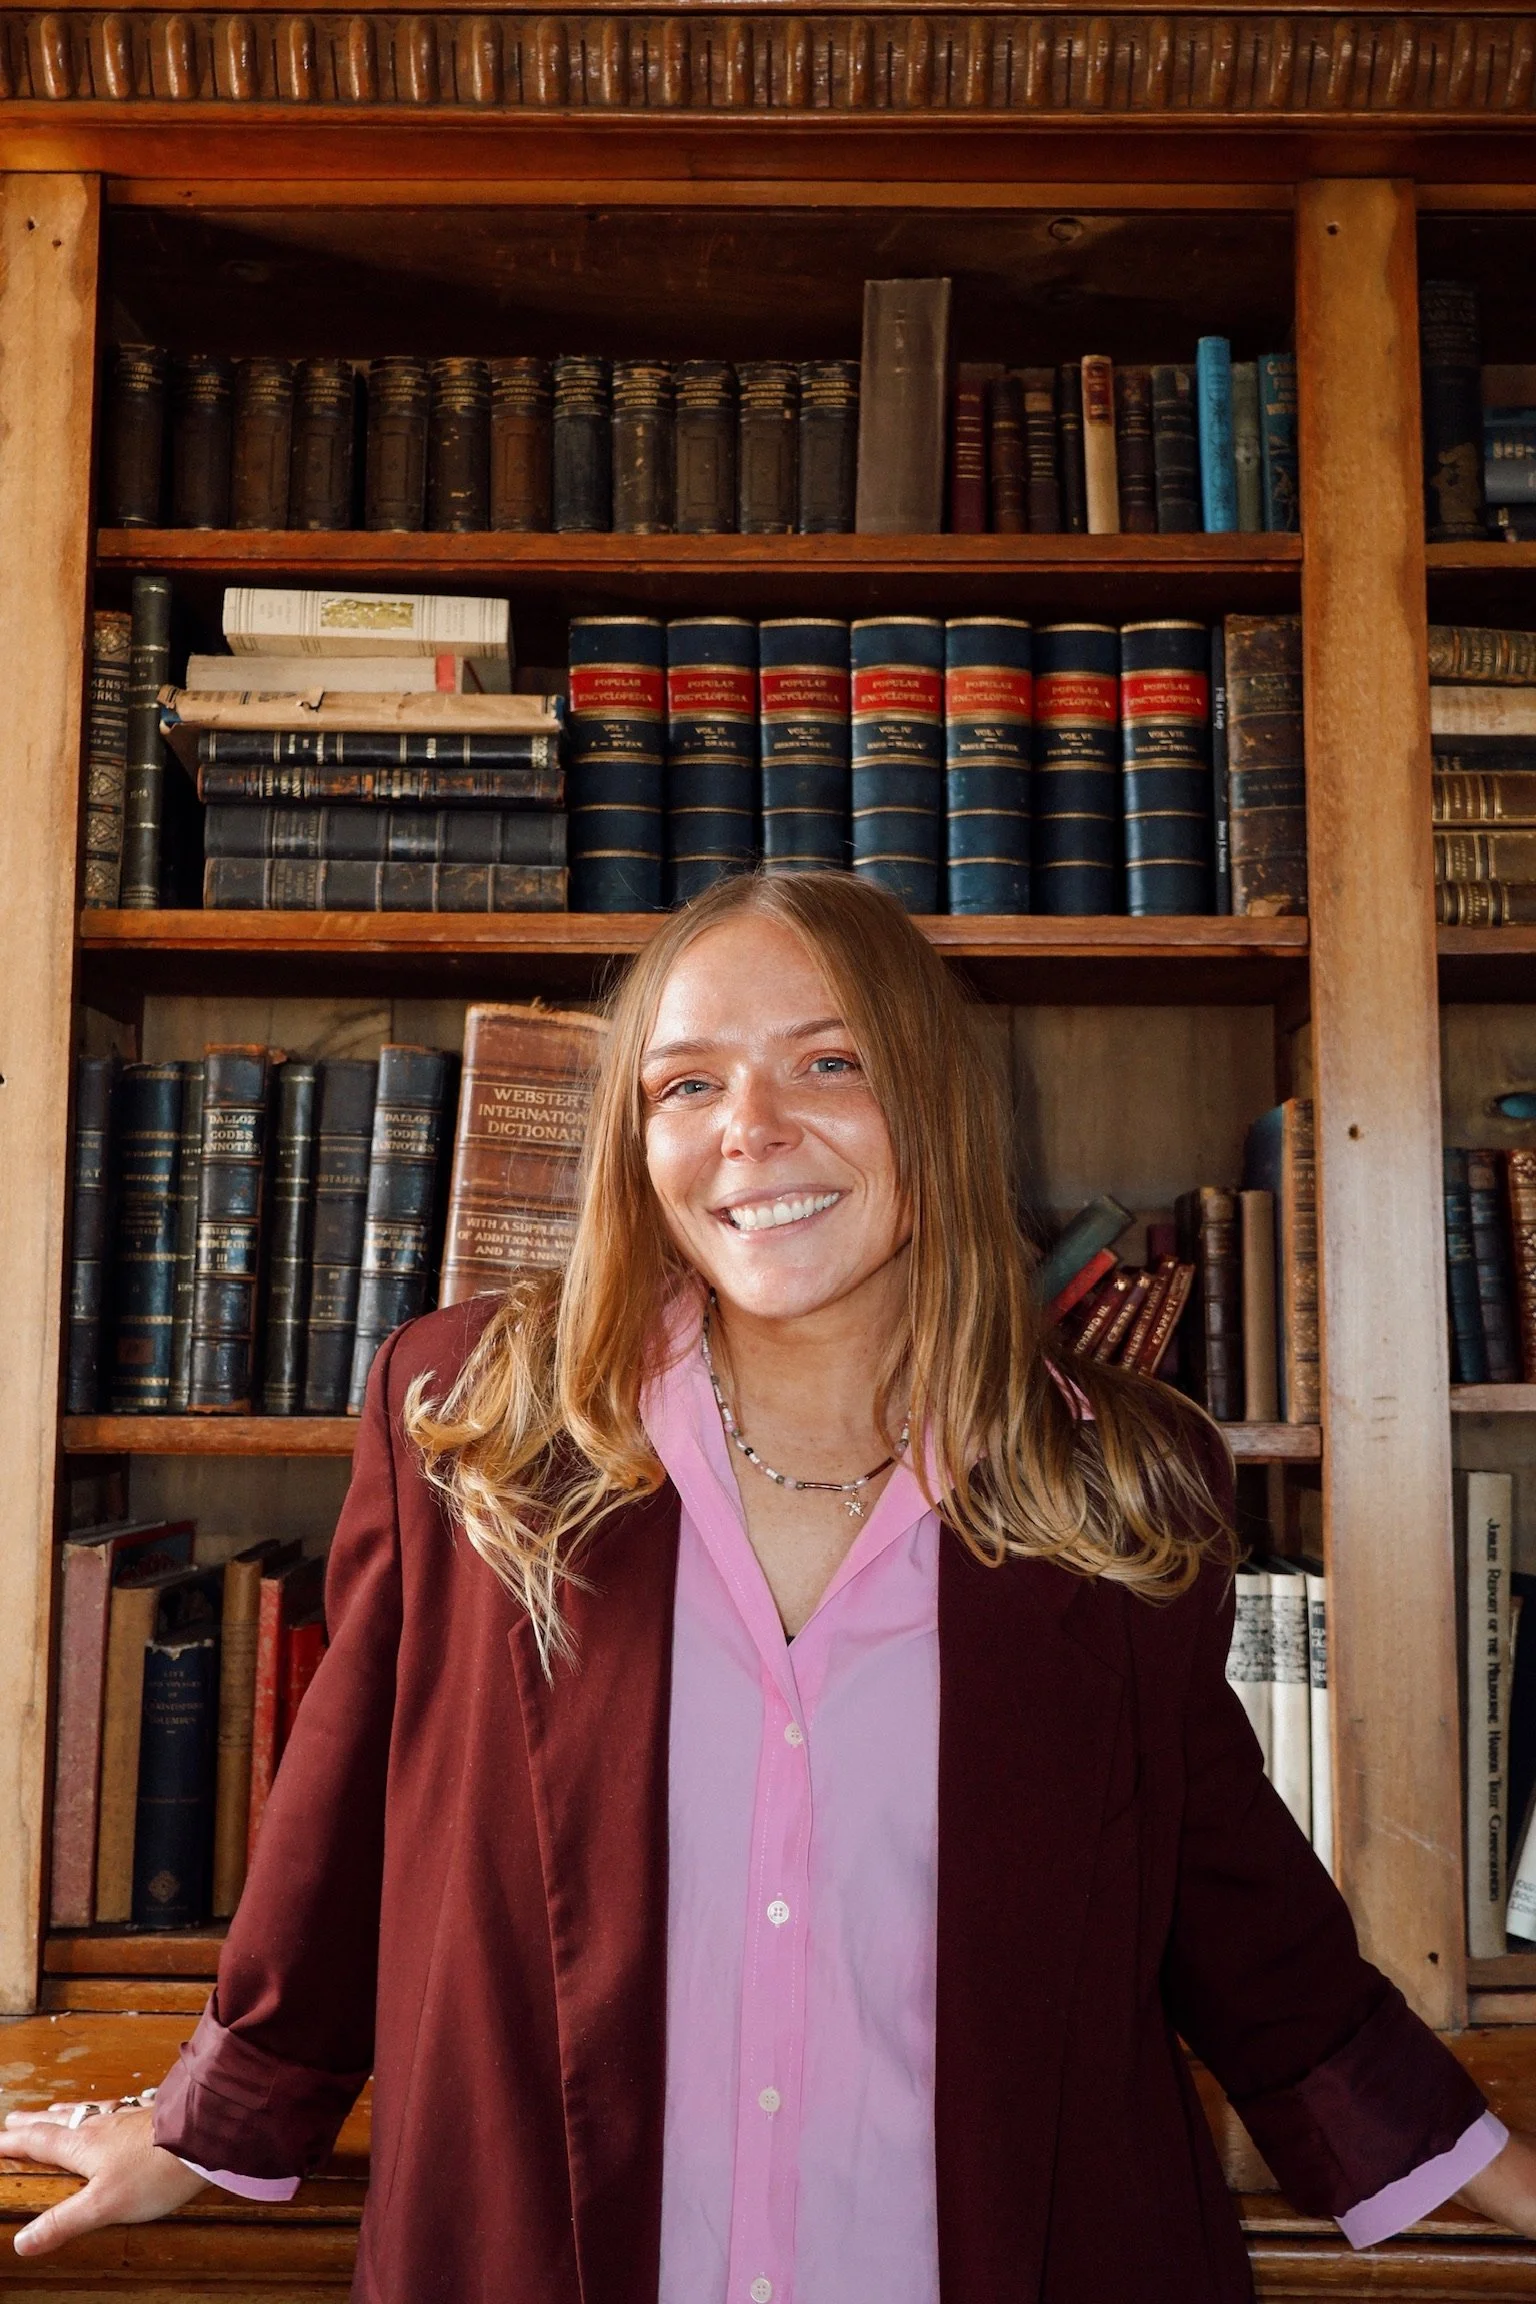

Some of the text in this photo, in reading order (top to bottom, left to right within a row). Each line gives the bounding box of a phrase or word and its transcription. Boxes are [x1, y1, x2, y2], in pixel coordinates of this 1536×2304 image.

[595, 679, 641, 688] POPULAR
[688, 680, 735, 689] POPULAR
[780, 680, 827, 689] POPULAR
[873, 679, 919, 689] POPULAR
[965, 681, 1012, 690] POPULAR
[1143, 683, 1190, 692] POPULAR
[1052, 685, 1099, 695] POPULAR
[493, 1087, 591, 1109] WEBSTER'S
[384, 1113, 431, 1125] DALLOZ
[478, 1103, 589, 1125] INTERNATION
[208, 1115, 257, 1125] DALLOZ
[210, 1130, 254, 1140] CODES
[384, 1129, 429, 1140] CODES
[487, 1120, 583, 1141] DICTIONAR
[466, 1217, 498, 1229] WITH
[500, 1220, 511, 1231] A
[458, 1230, 473, 1241] OF
[475, 1245, 504, 1257] AND
